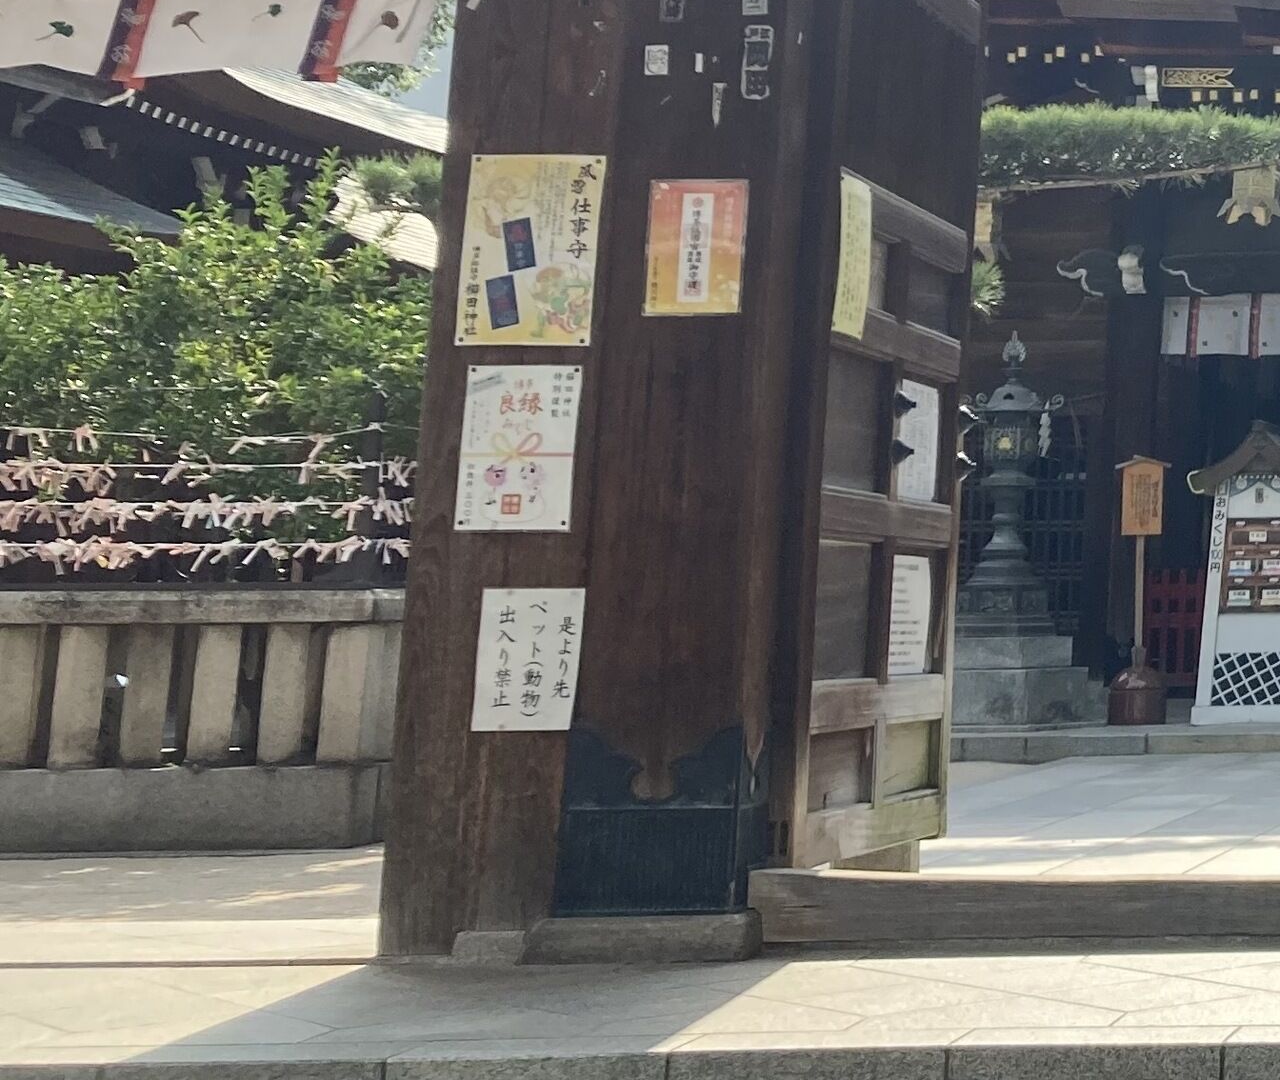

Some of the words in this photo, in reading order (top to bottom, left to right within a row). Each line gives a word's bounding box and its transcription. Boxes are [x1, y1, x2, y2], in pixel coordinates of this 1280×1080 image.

[500, 390, 544, 416] 良縁
[490, 605, 517, 708] 出入り禁止
[551, 616, 577, 699] 是より先
